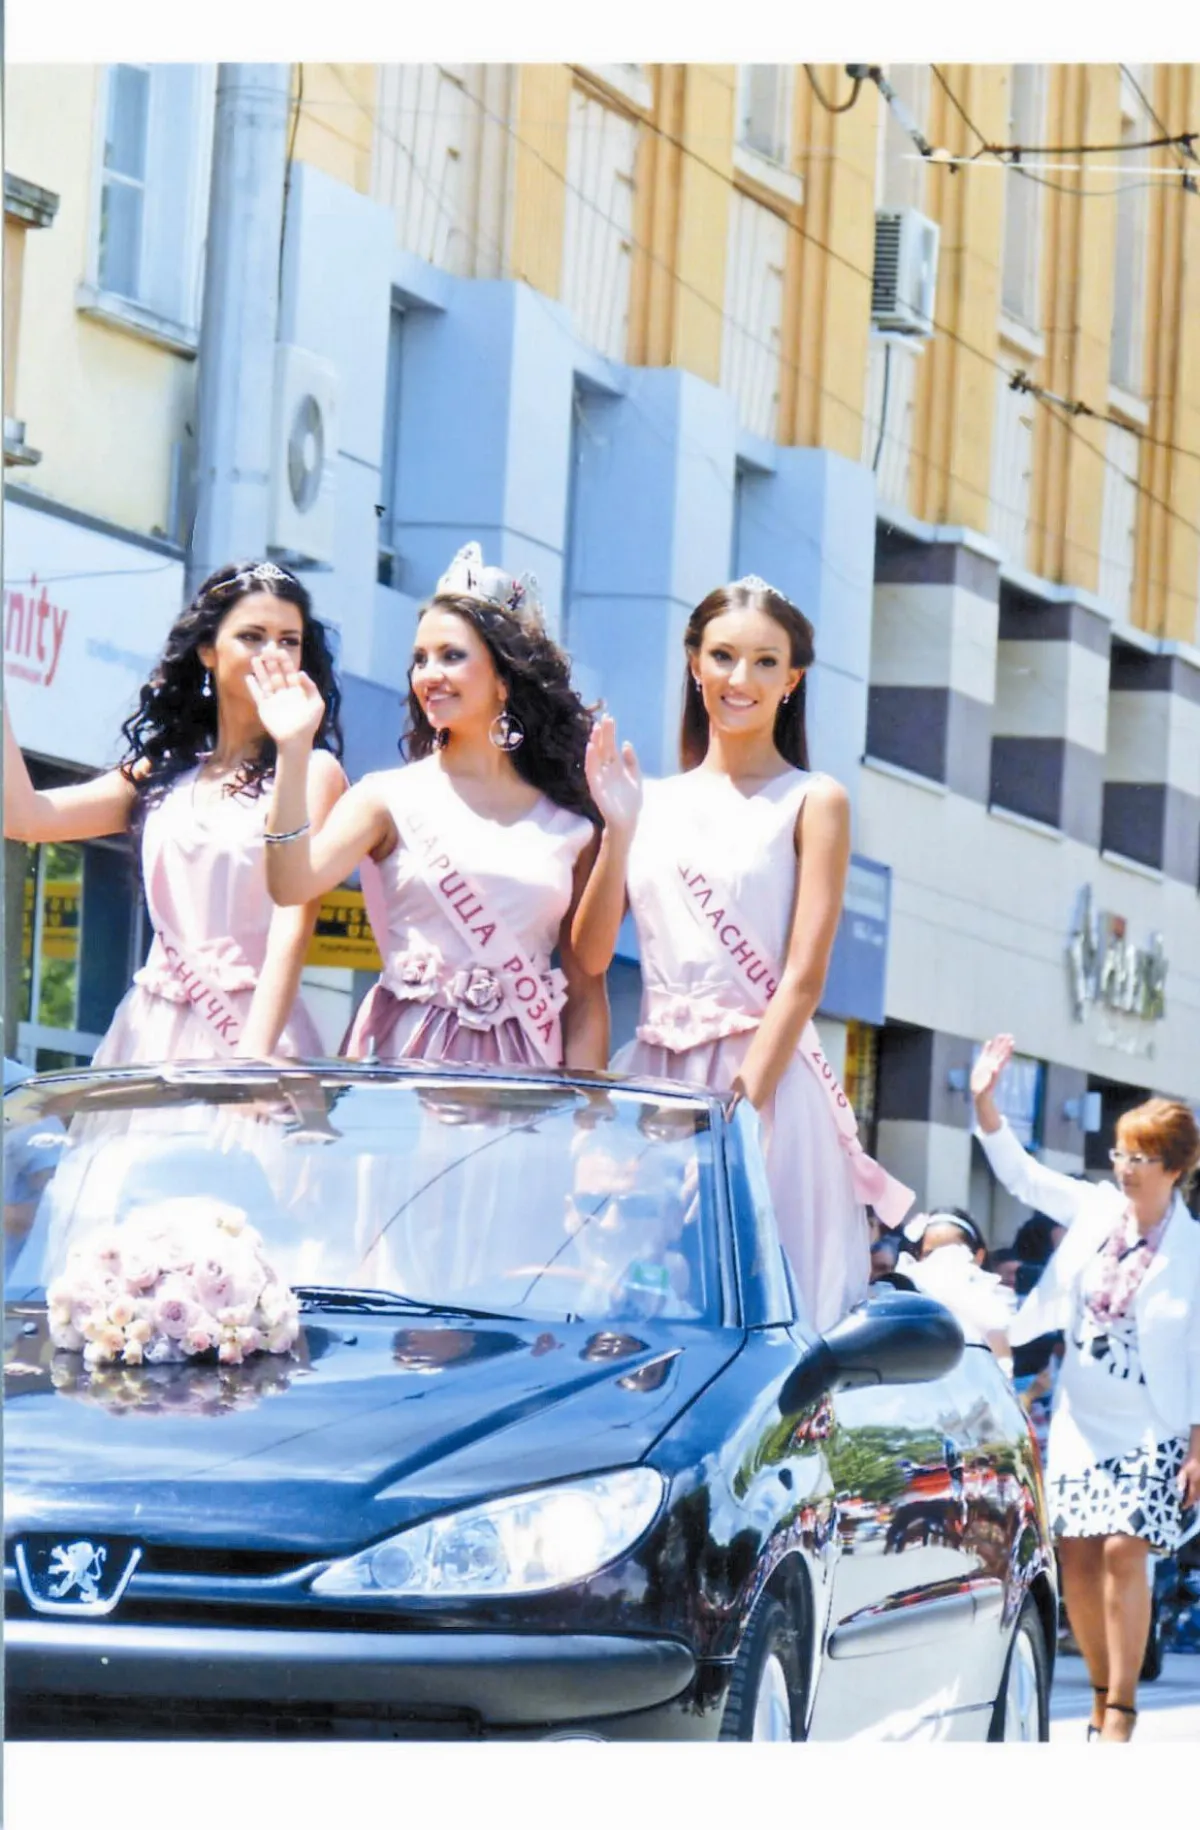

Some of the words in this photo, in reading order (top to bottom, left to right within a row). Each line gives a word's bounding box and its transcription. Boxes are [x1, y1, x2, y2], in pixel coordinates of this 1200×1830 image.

[158, 931, 240, 1046] СНИЧК
[404, 814, 496, 948] ЦАРИЦА
[503, 954, 555, 1044] РОЗА
